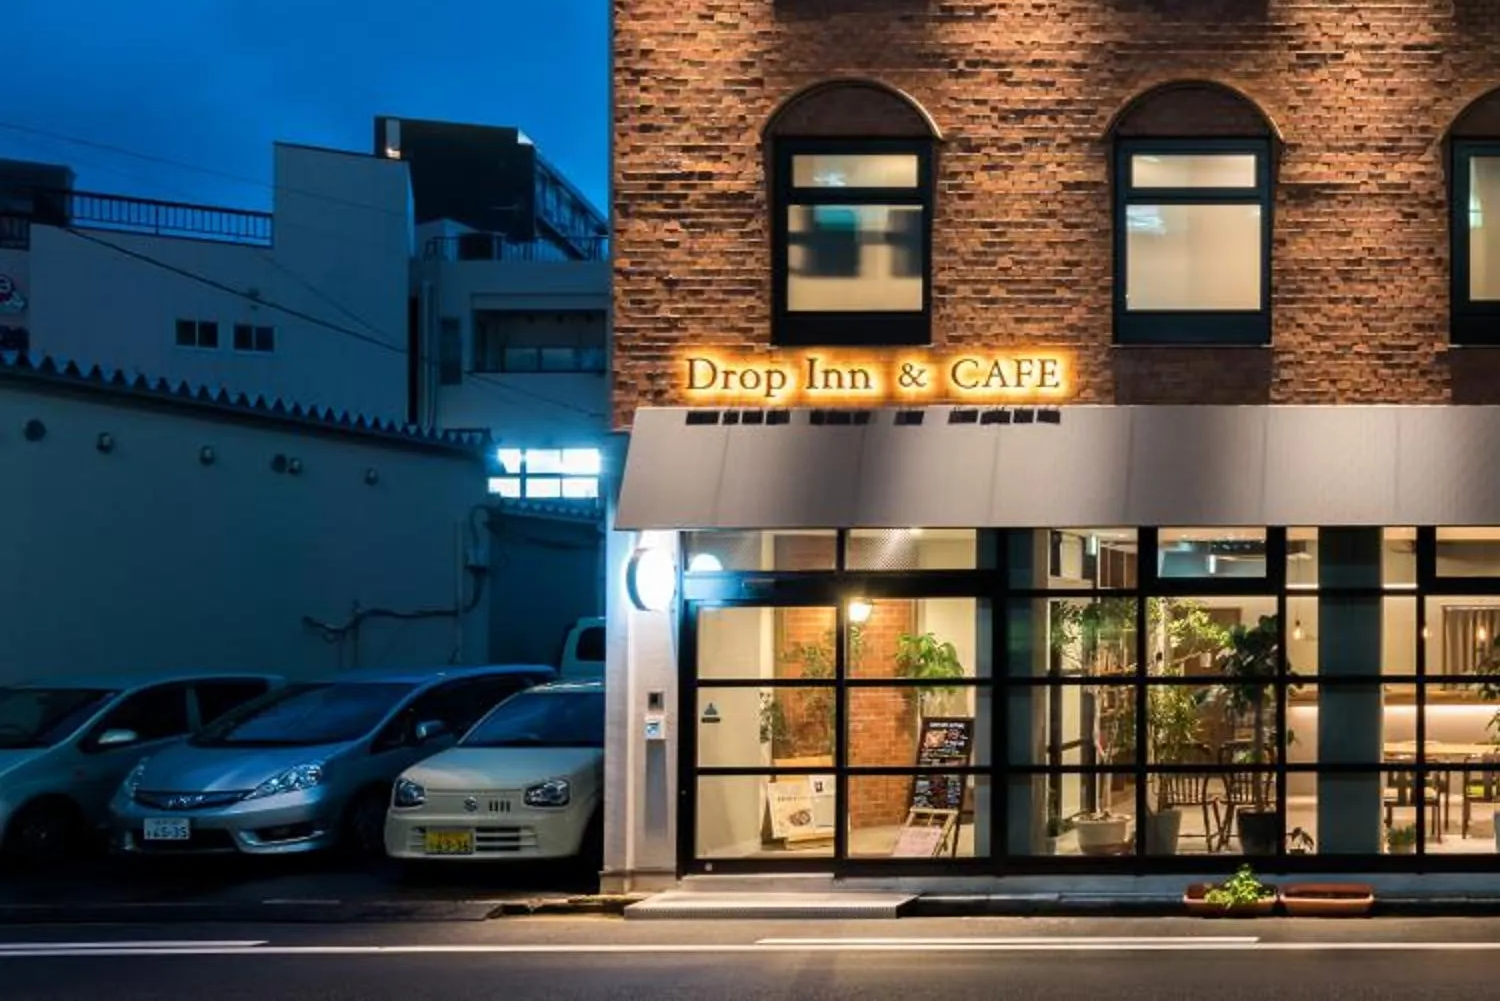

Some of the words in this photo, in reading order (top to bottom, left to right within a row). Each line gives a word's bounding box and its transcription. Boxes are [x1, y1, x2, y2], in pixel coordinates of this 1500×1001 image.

[686, 358, 787, 397] Drop
[805, 358, 872, 390] Inn
[898, 362, 927, 387] &
[951, 358, 1059, 389] CAFE
